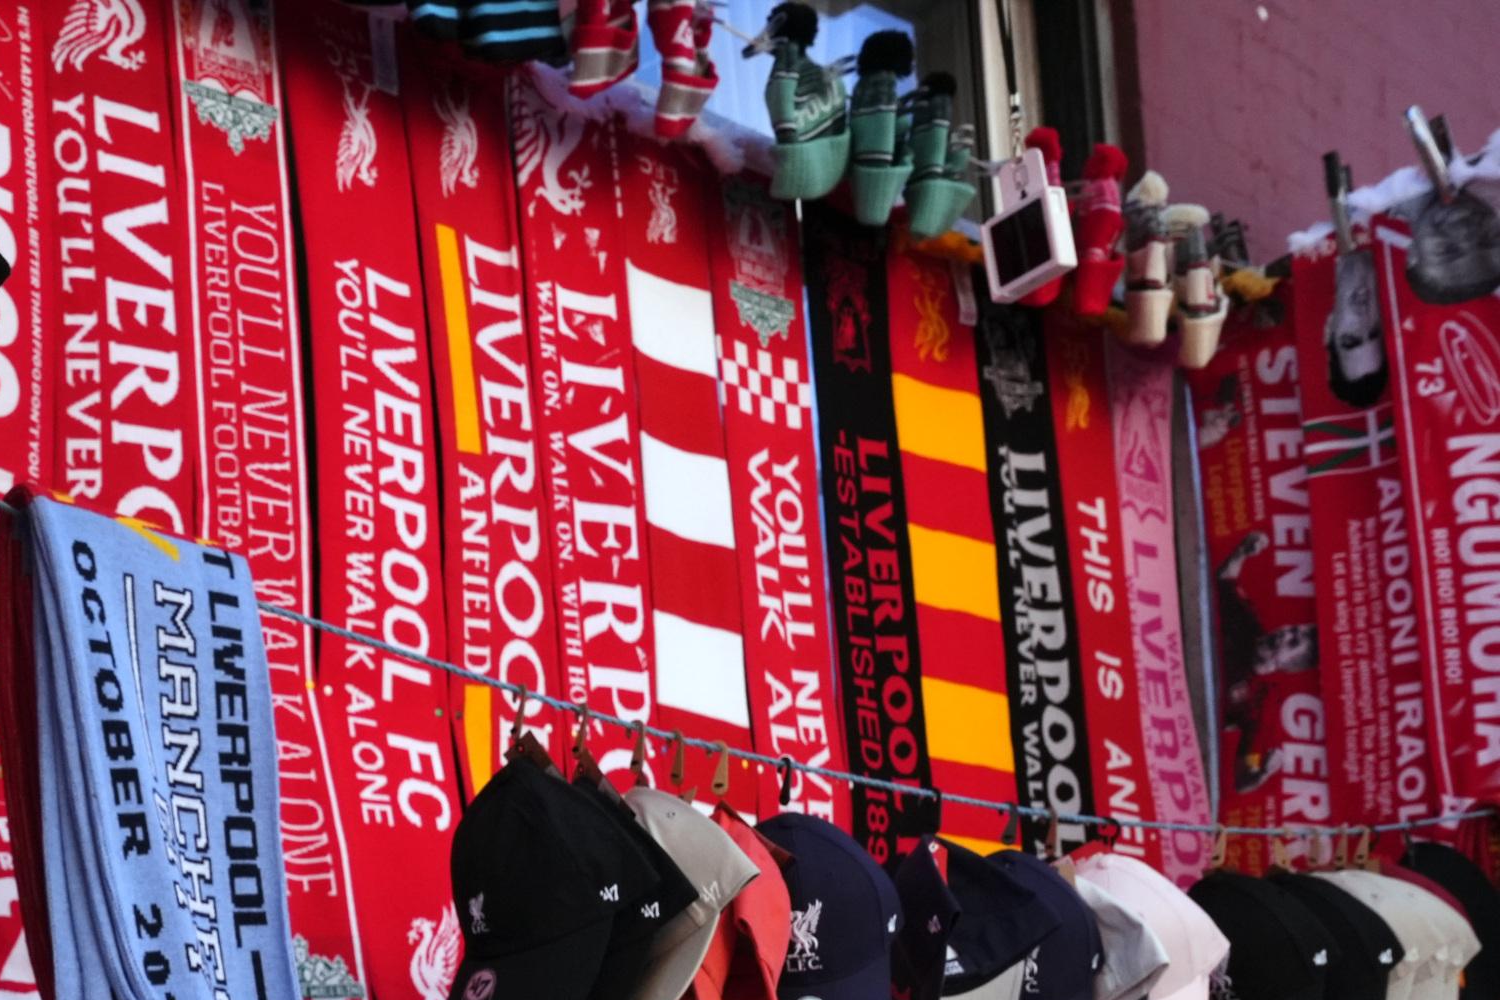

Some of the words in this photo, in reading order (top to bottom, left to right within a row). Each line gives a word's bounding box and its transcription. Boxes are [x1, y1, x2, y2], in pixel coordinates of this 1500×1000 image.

[52, 93, 99, 295] YOU'LL
[200, 180, 234, 390] LIVERPOOL
[230, 201, 286, 368] YOU'LL
[62, 312, 103, 500] NEVER
[333, 257, 368, 392] YOU'LL
[240, 384, 298, 560] NEVER
[343, 403, 376, 542] NEVER
[364, 266, 432, 702] LIVERPOOL
[535, 280, 559, 362] WALK
[549, 430, 571, 512] WALK
[560, 581, 584, 659] WITH
[747, 448, 789, 644] WALK
[771, 455, 816, 651] YOU'LL
[1076, 497, 1116, 614] THIS
[1255, 344, 1316, 599] STEVEN
[257, 576, 304, 724] WALK
[345, 552, 377, 671] WALK
[457, 462, 493, 677] ANFIELD
[1006, 451, 1087, 858] LIVERPOOL
[1376, 476, 1421, 667] ANDONI
[71, 538, 151, 862] OCTOBER
[206, 590, 268, 950] LIVERPOOL
[345, 683, 396, 830] ALONE
[1094, 650, 1125, 701] IS
[277, 743, 339, 902] ALONE
[386, 731, 451, 834] FC
